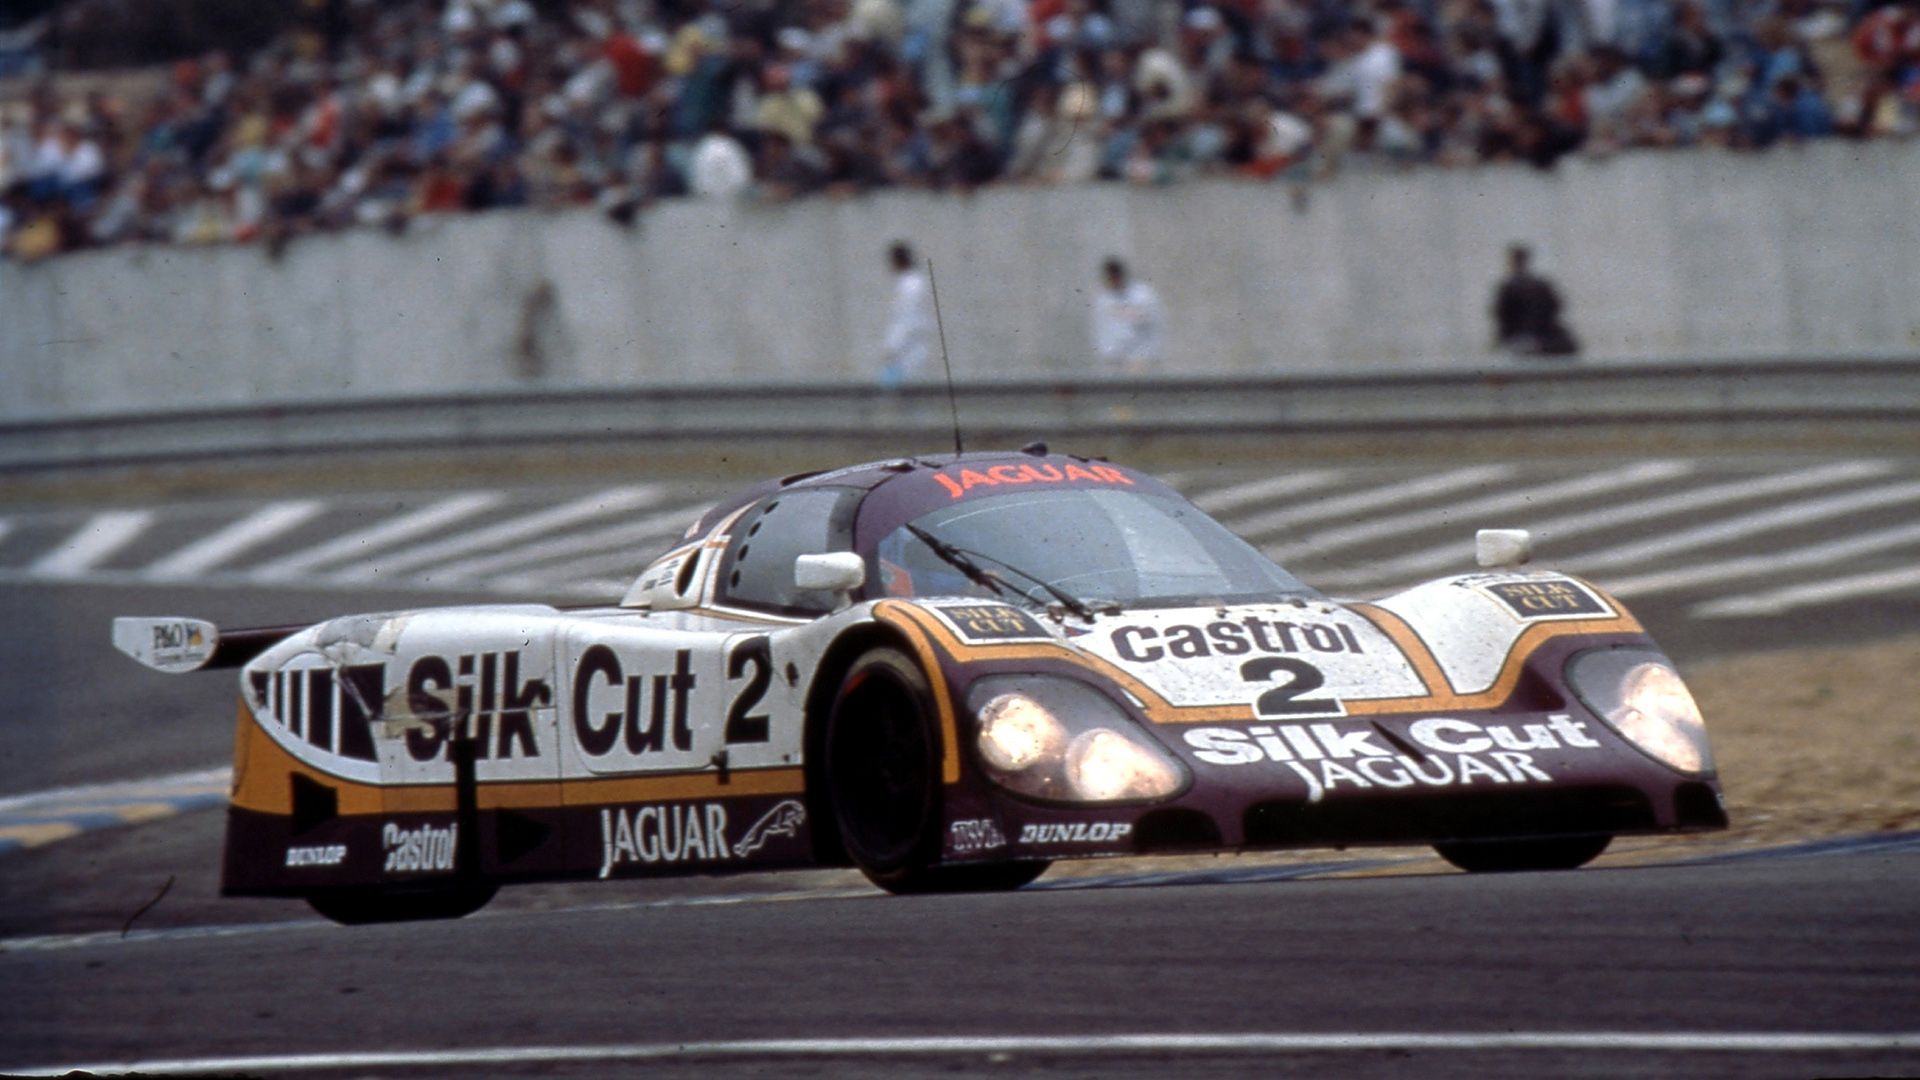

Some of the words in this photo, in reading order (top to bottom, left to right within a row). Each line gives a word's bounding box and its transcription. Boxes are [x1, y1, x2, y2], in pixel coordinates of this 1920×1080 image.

[933, 464, 1135, 498] JAGUAR
[1503, 583, 1575, 598] SILK
[1521, 595, 1582, 610] CUT
[952, 605, 1021, 620] SILK
[968, 618, 1027, 633] CUT
[1110, 616, 1364, 662] Castrol
[407, 651, 552, 762] Silk
[573, 644, 697, 757] Cut
[725, 636, 772, 745] 2
[1239, 656, 1342, 716] 2
[1183, 724, 1392, 765] Silk
[1409, 714, 1600, 753] Cut
[1284, 752, 1552, 802] JAGUAR
[383, 822, 457, 872] Castrol
[600, 804, 730, 878] JAGUAR
[1018, 823, 1133, 843] DUNLOP
[285, 845, 348, 866] DUNLOP
